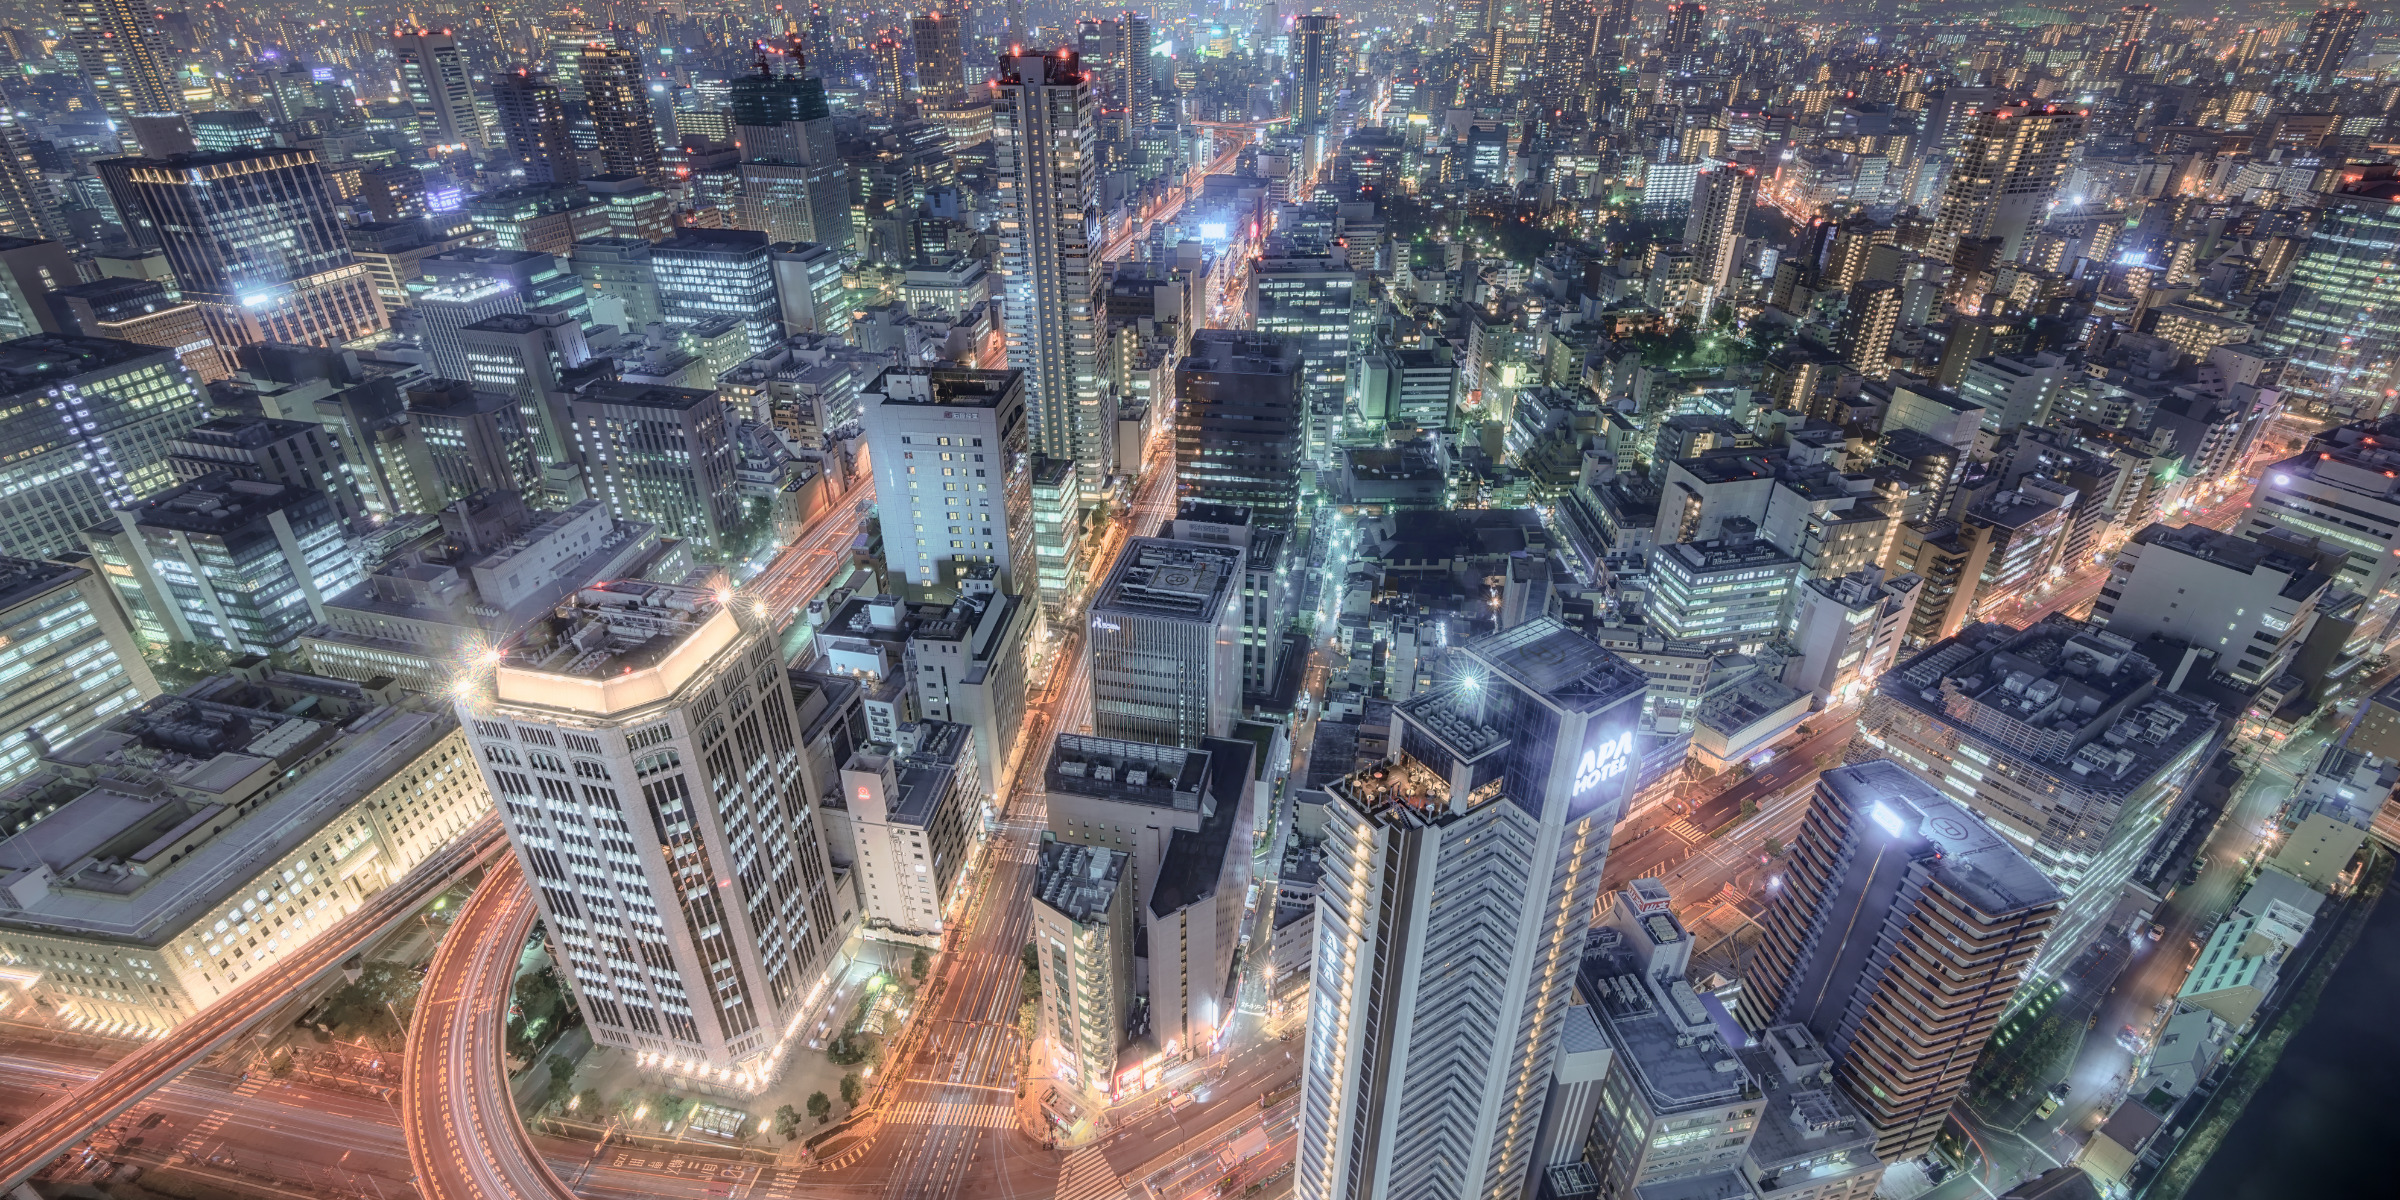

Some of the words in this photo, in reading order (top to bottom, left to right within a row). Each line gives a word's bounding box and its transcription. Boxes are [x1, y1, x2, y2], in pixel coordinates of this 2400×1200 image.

[1188, 523, 1230, 534] 明治安田生命
[1572, 756, 1627, 797] HOTEL
[1575, 730, 1632, 779] APA
[1644, 901, 1669, 911] 山文
[1323, 930, 1337, 985] APA
[1316, 992, 1332, 1073] HOTEL
